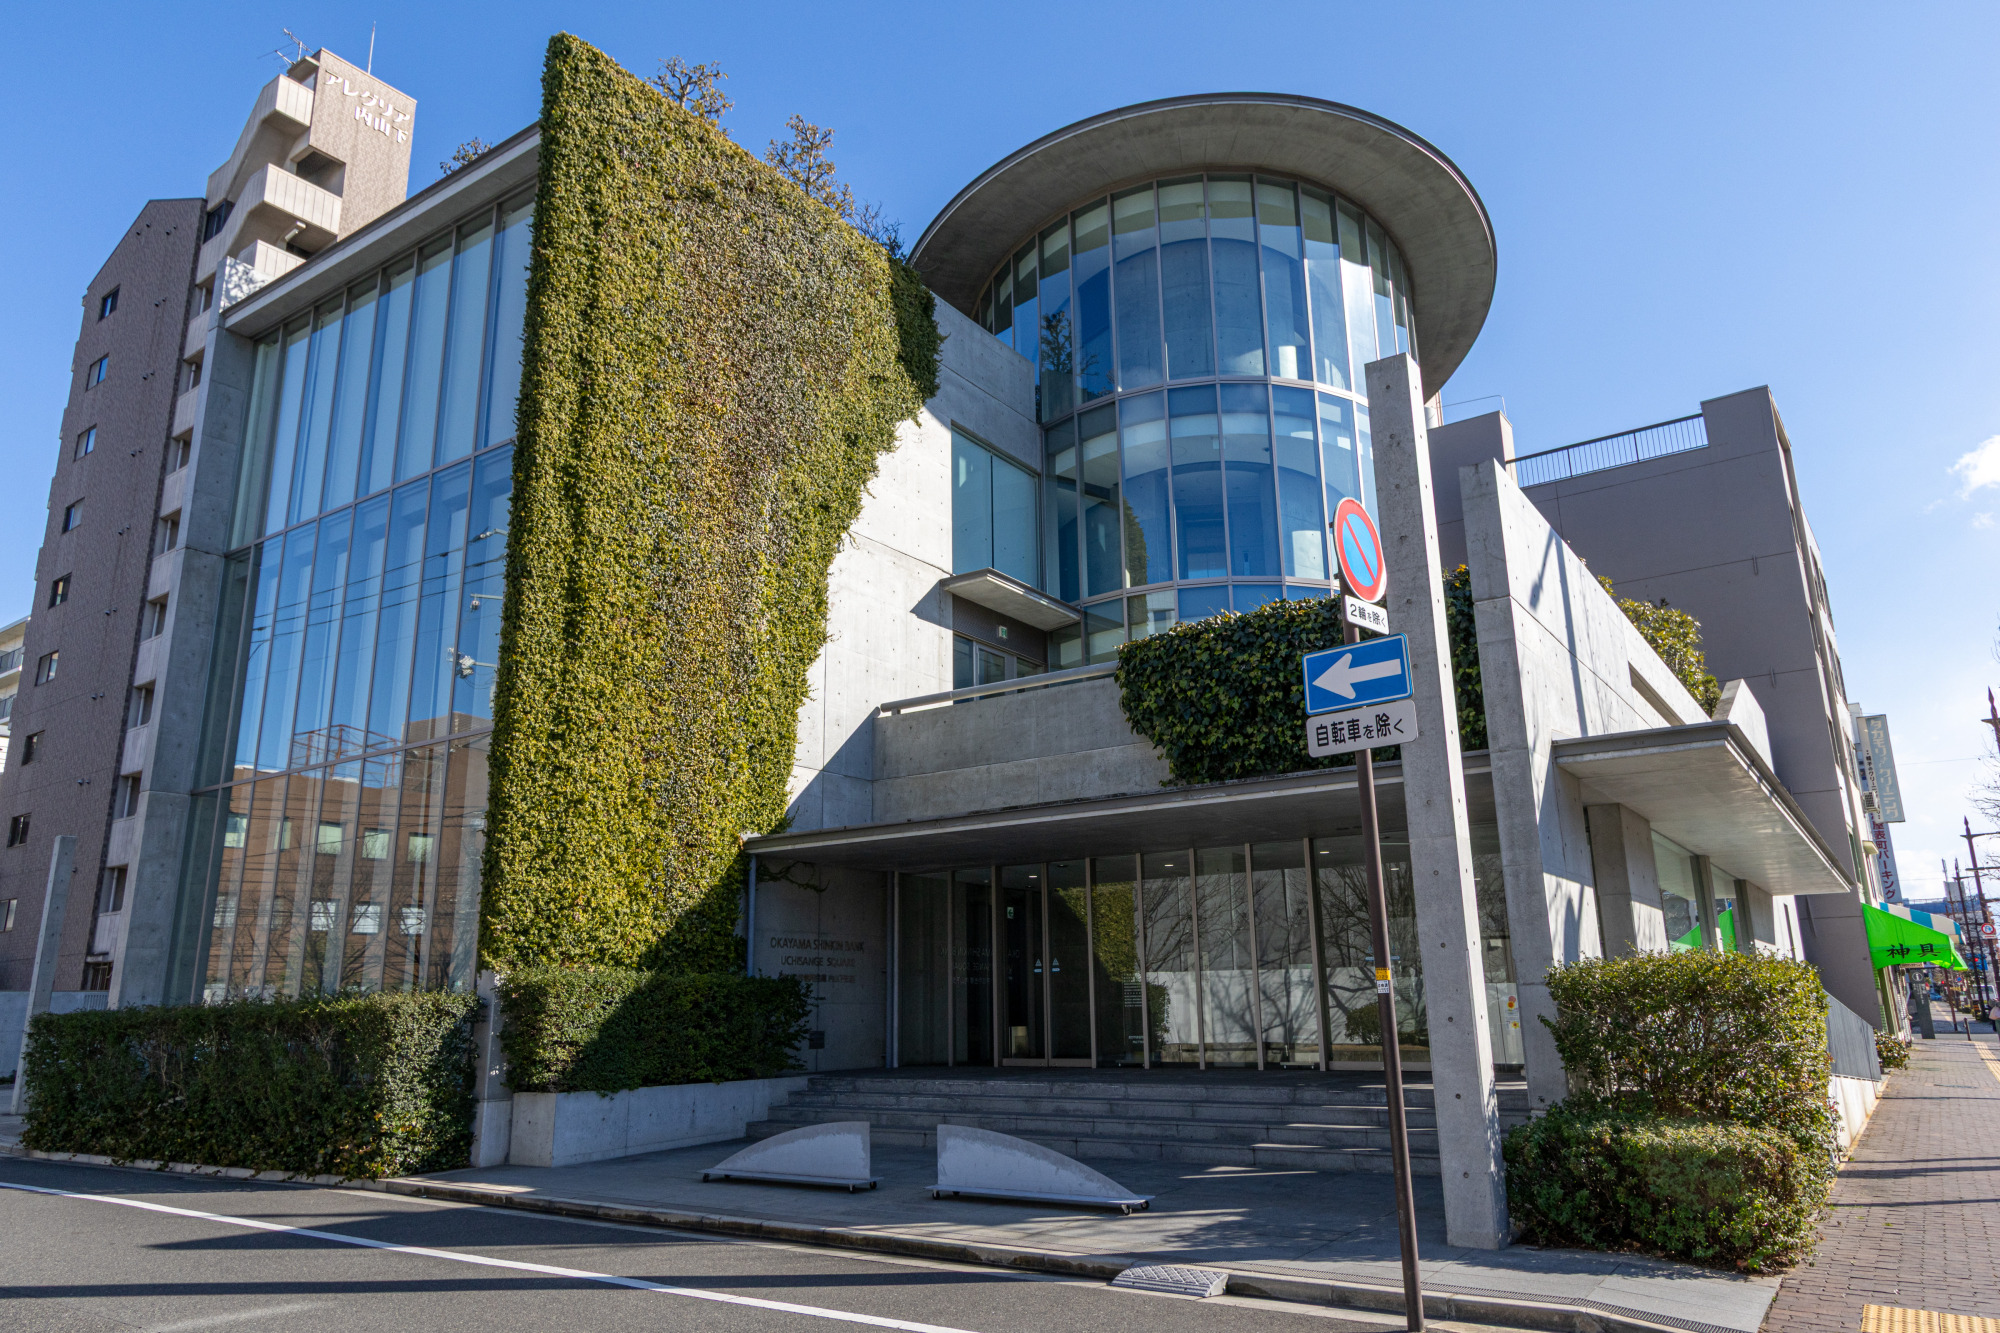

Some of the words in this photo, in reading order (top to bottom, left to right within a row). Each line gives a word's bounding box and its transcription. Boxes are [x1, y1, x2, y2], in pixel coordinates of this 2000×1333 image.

[325, 69, 411, 123] アレグリア
[354, 105, 409, 144] 内山下
[1350, 603, 1388, 629] 2輪を除く
[1315, 712, 1405, 748] 自転車を除く
[770, 936, 811, 950] OKAYAMA
[1886, 943, 1941, 959] 神具
[781, 955, 823, 967] UCHISANGE
